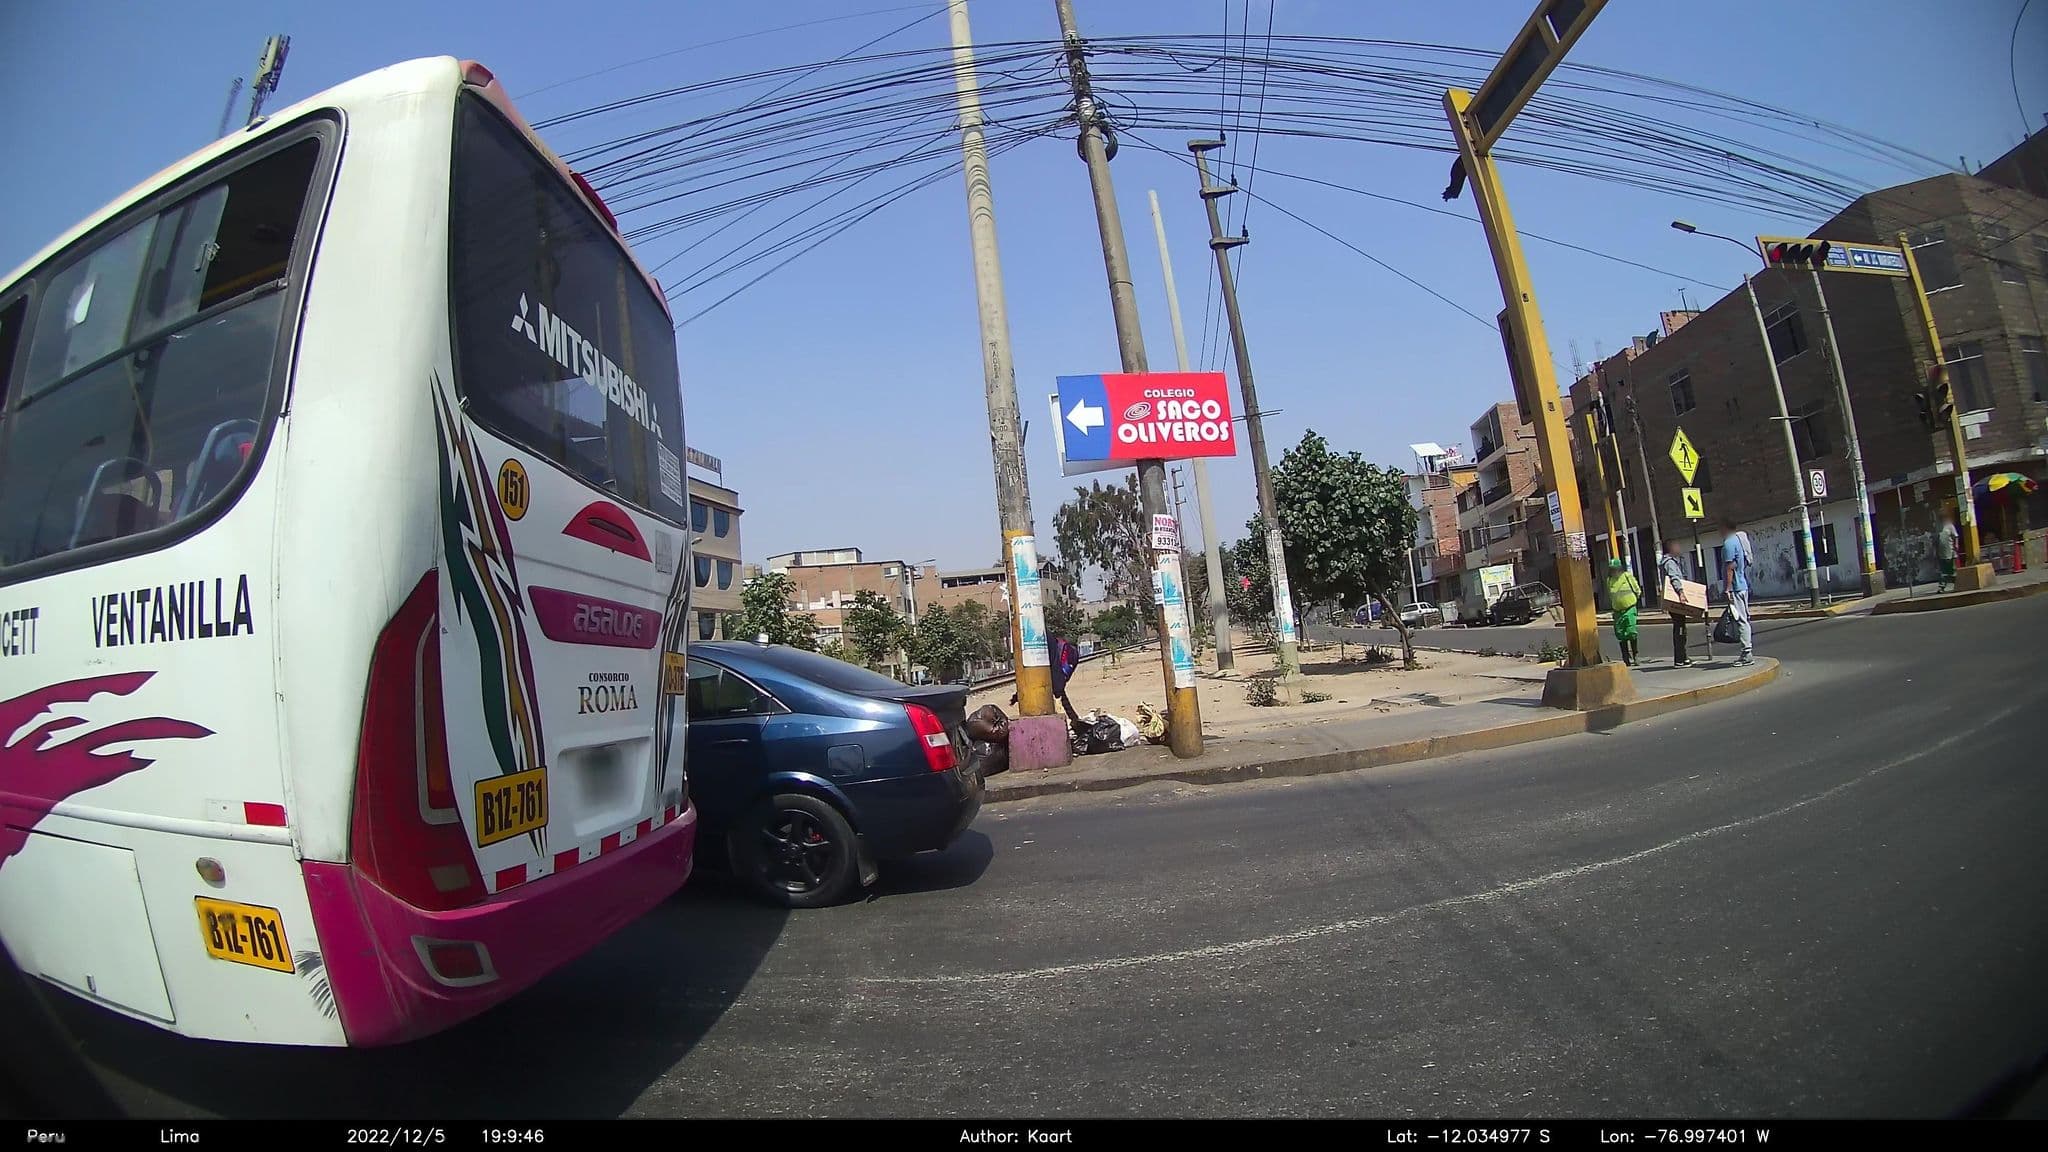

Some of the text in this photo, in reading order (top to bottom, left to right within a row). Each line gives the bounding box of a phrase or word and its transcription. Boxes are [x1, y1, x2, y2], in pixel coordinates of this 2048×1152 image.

[538, 302, 650, 431] MITSUBISHI
[1144, 389, 1195, 398] COLEGIO
[1156, 400, 1221, 420] SACO
[1117, 421, 1230, 444] OLIVEROS
[503, 468, 524, 509] 151
[92, 574, 254, 648] VENTANILLA
[0, 607, 40, 657] CETT
[588, 672, 630, 682] CONSORCIO
[577, 684, 638, 714] ROMA
[482, 778, 543, 836] B1Z-761
[207, 911, 286, 962] B1Z-761
